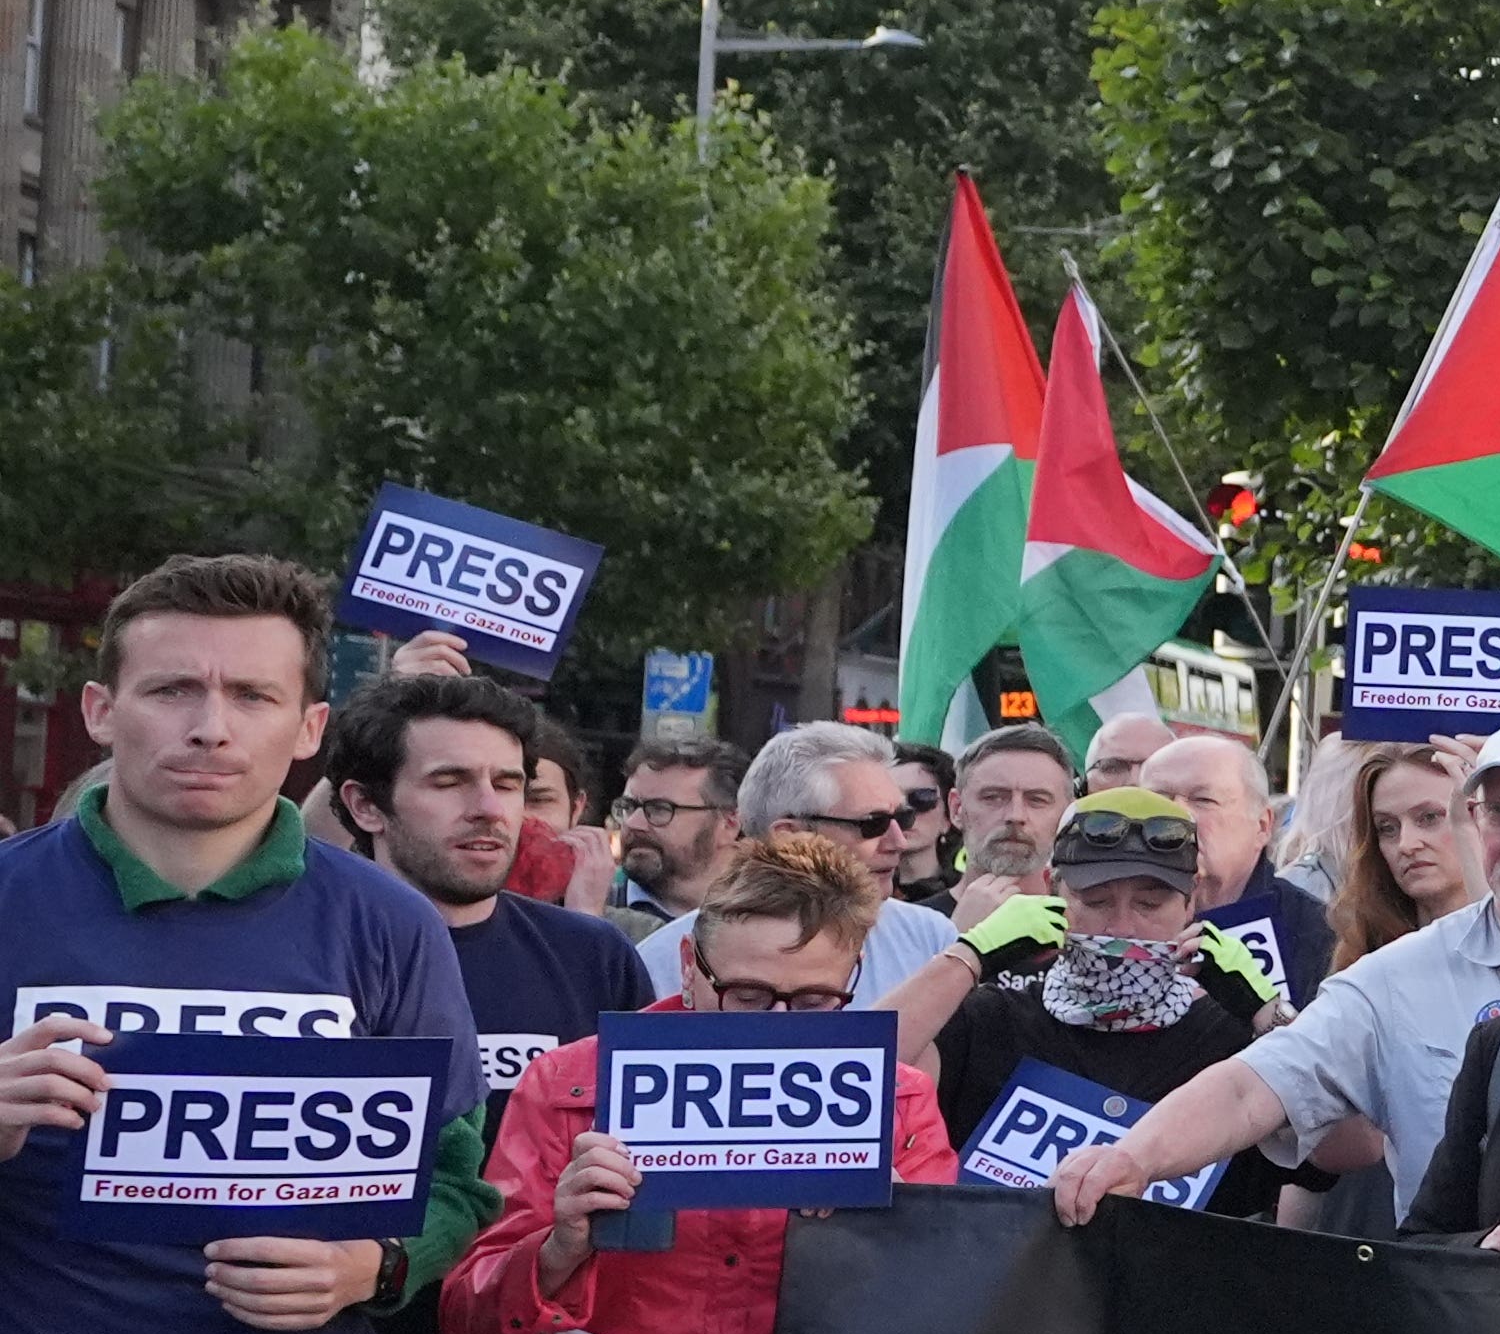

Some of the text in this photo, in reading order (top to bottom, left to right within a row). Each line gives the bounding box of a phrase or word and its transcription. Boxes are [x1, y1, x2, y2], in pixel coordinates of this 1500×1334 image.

[371, 522, 568, 618] PRESS
[359, 582, 546, 646] Freedom for Gaza now
[1361, 691, 1430, 706] Freedom
[1438, 693, 1460, 707] for
[99, 1089, 413, 1162] PRESS
[620, 1060, 873, 1129] PRESS
[725, 1148, 757, 1166] for
[763, 1148, 817, 1167] Gaza
[825, 1149, 869, 1165] now
[94, 1180, 403, 1202] Freedom for Gaza now
